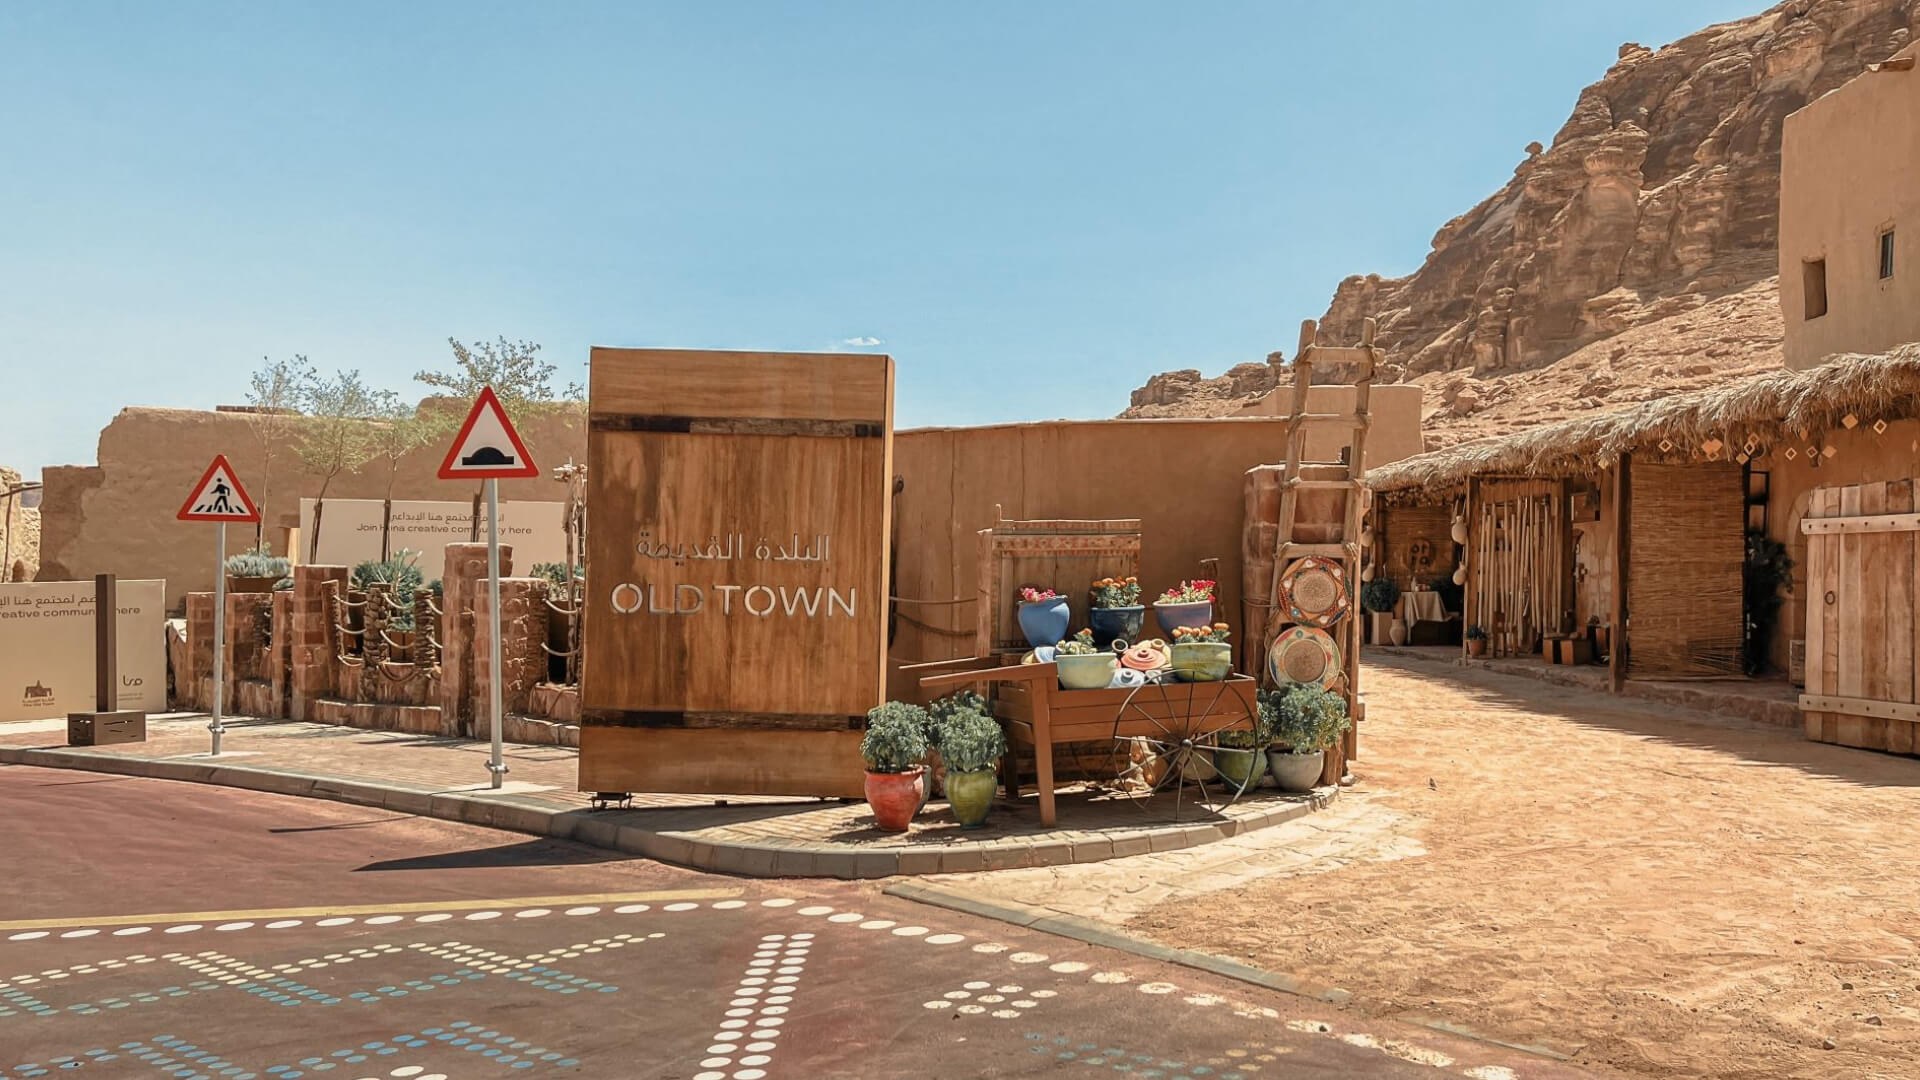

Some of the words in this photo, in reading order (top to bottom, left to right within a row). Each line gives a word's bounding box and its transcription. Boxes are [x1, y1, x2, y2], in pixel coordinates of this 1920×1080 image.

[428, 511, 443, 520] هنا
[356, 523, 377, 532] Join
[408, 525, 449, 533] creative
[509, 525, 533, 534] here
[636, 531, 743, 566] القديمة
[755, 533, 830, 567] البلدة
[14, 595, 33, 606] هنا
[611, 583, 704, 614] OLD
[713, 584, 856, 617] TOWN
[0, 611, 40, 619] eative
[43, 607, 95, 617] commun
